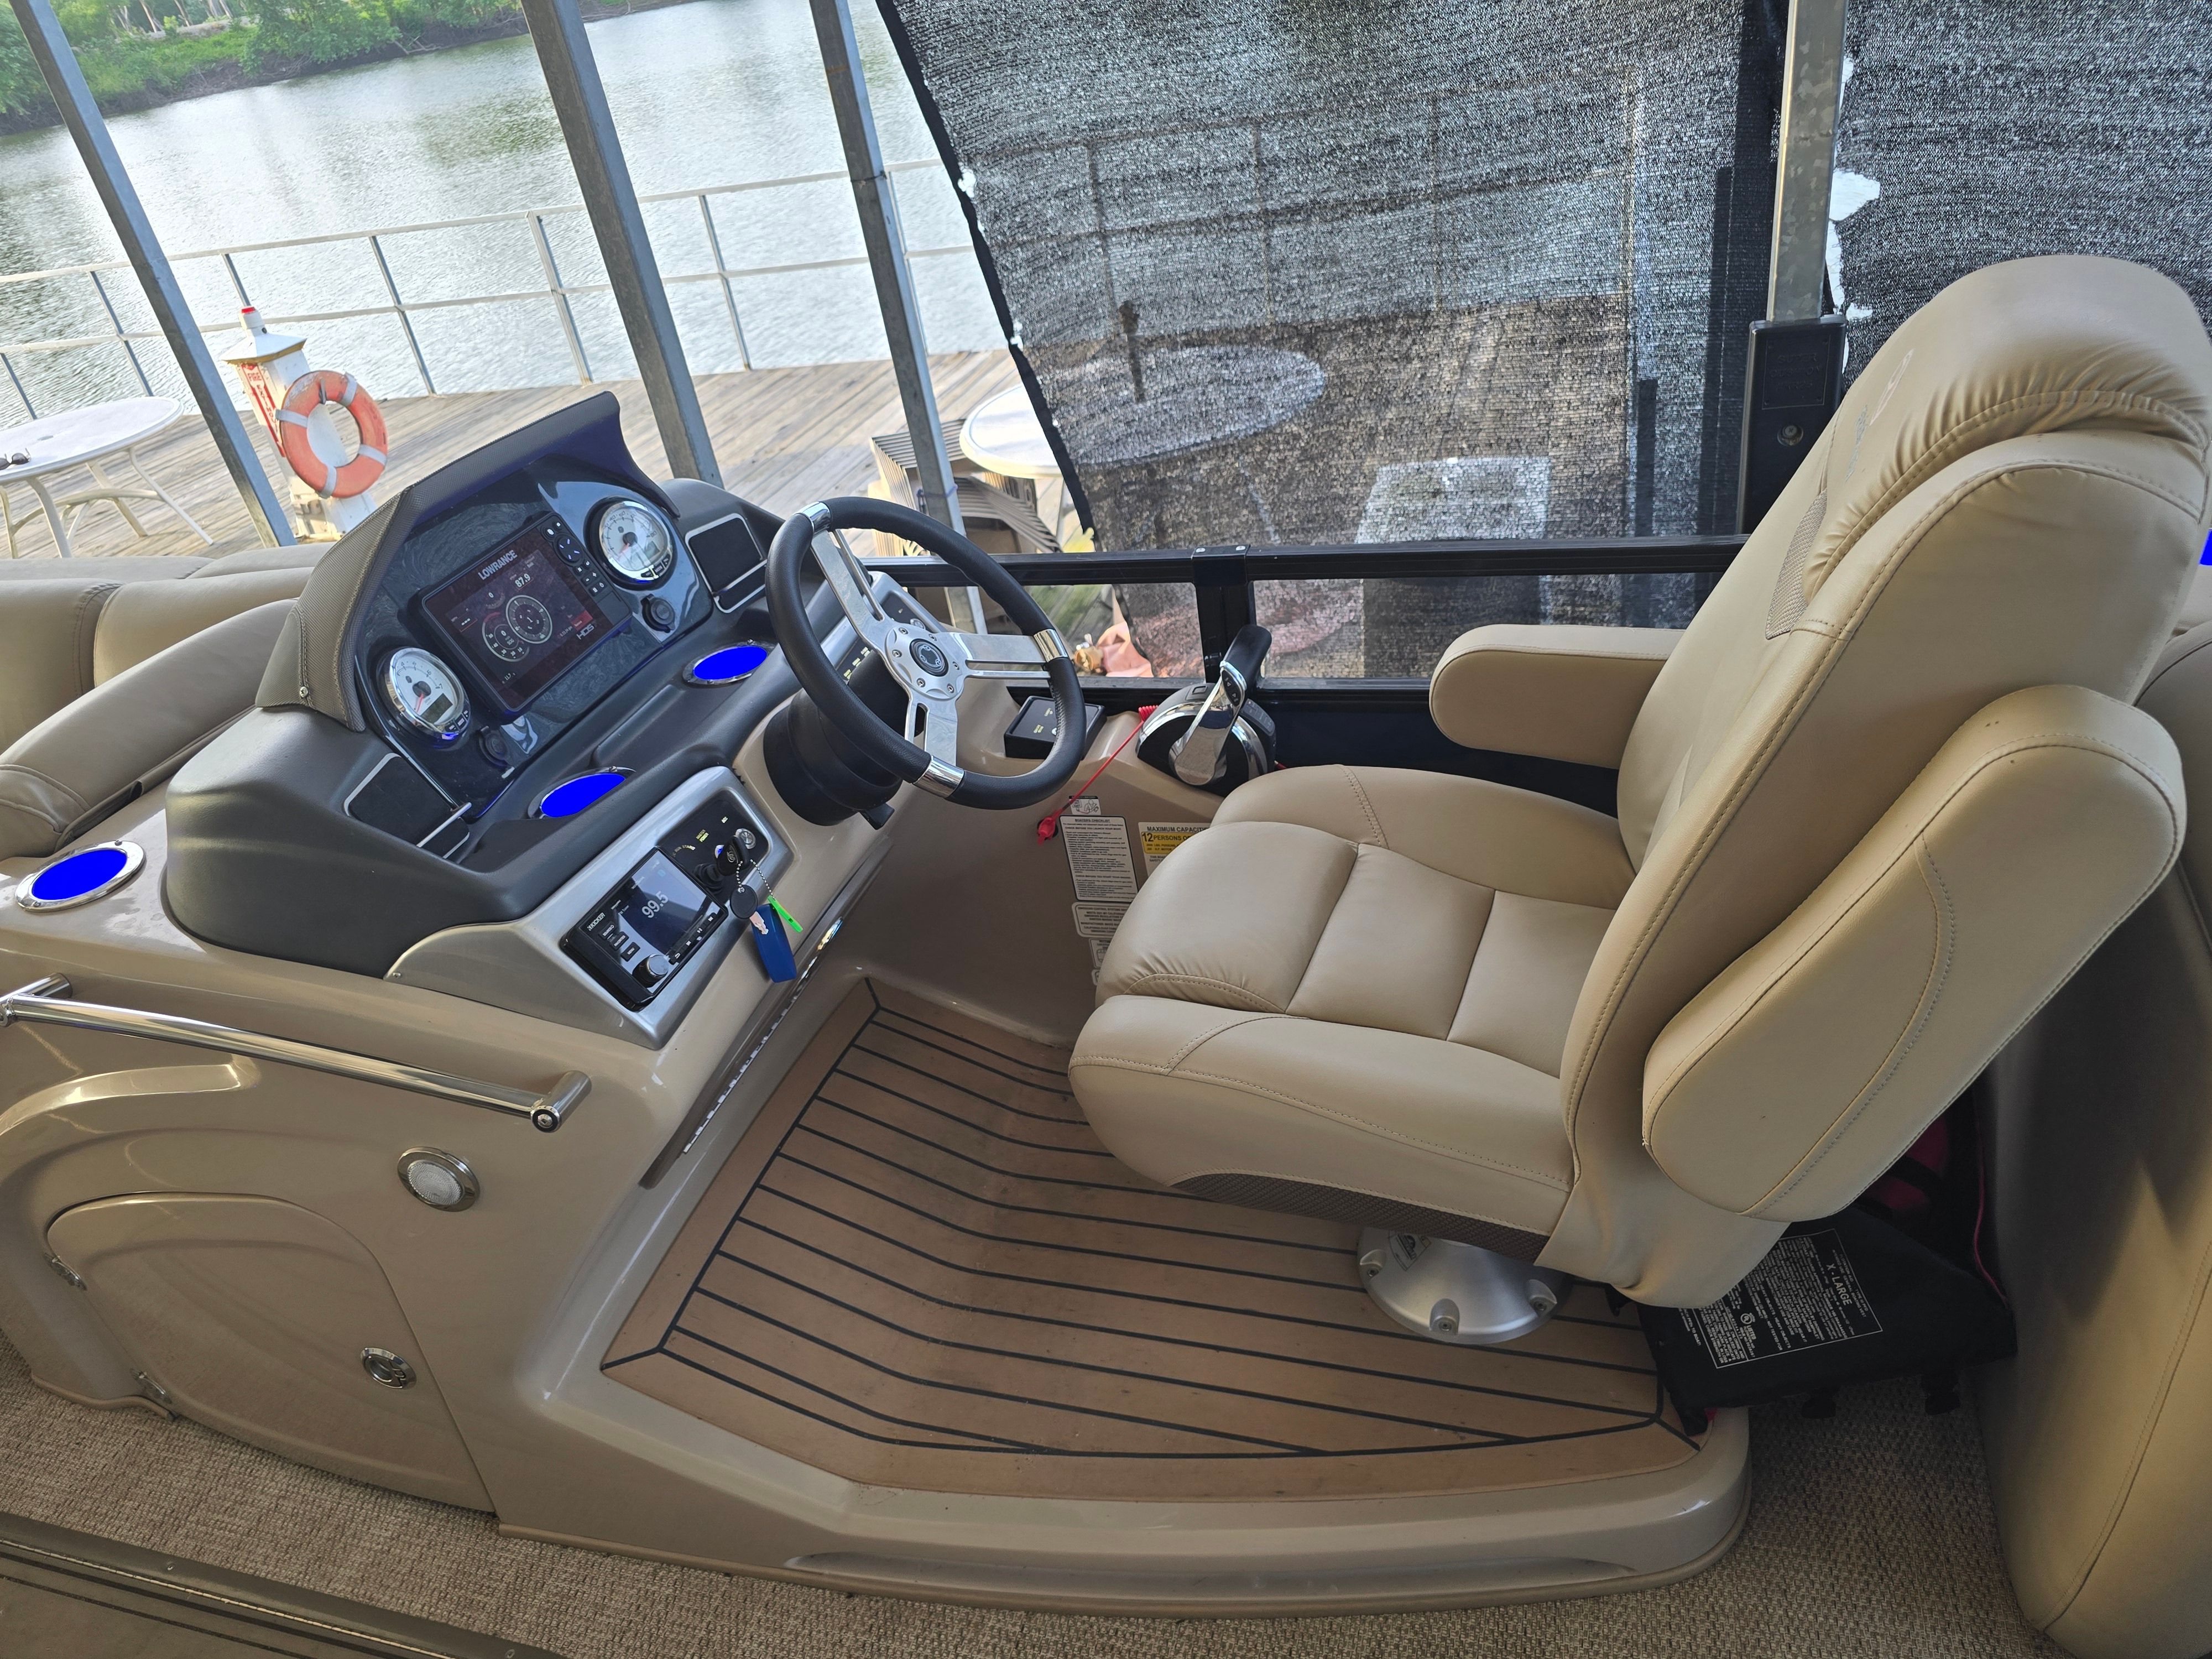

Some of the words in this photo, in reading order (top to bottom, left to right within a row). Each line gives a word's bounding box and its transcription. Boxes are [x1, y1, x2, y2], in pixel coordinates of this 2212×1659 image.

[247, 372, 262, 382] FIRE
[478, 549, 518, 580] LOWRANCE
[515, 573, 531, 588] 87.9
[576, 623, 595, 640] HDS
[1141, 832, 1154, 842] 12
[641, 890, 669, 919] 99.5
[587, 912, 606, 931] KICKER
[1813, 1272, 1824, 1292] APPROVAL
[1823, 1293, 1833, 1309] NUMBER
[1832, 1276, 1853, 1305] LARGE
[1843, 1275, 1853, 1291] GENERAL
[1851, 1292, 1861, 1308] BOATING
[1753, 1271, 1761, 1284] CARRY
[1765, 1297, 1775, 1314] OBJECTS
[1774, 1317, 1782, 1329] HEAVY
[1780, 1330, 1791, 1348] OBJECTS
[1779, 1279, 1789, 1295] CHECKS
[1792, 1307, 1802, 1323] SEASON
[1788, 1290, 1798, 1303] DEVICE
[1800, 1313, 1812, 1332] PERFORM
[1755, 1306, 1764, 1318] IMPACT
[1804, 1303, 1813, 1315] DEATH
[1813, 1321, 1825, 1340] DROWNING
[1746, 1325, 1756, 1339] LISTED
[1770, 1329, 1779, 1342] TESTED
[1797, 1327, 1806, 1338] WEAR
[1808, 1319, 1819, 1339] PAMPHLET
[1710, 1337, 1721, 1357] STRENGTH
[1717, 1322, 1725, 1335] FADING
[1726, 1344, 1736, 1360] INDICATE
